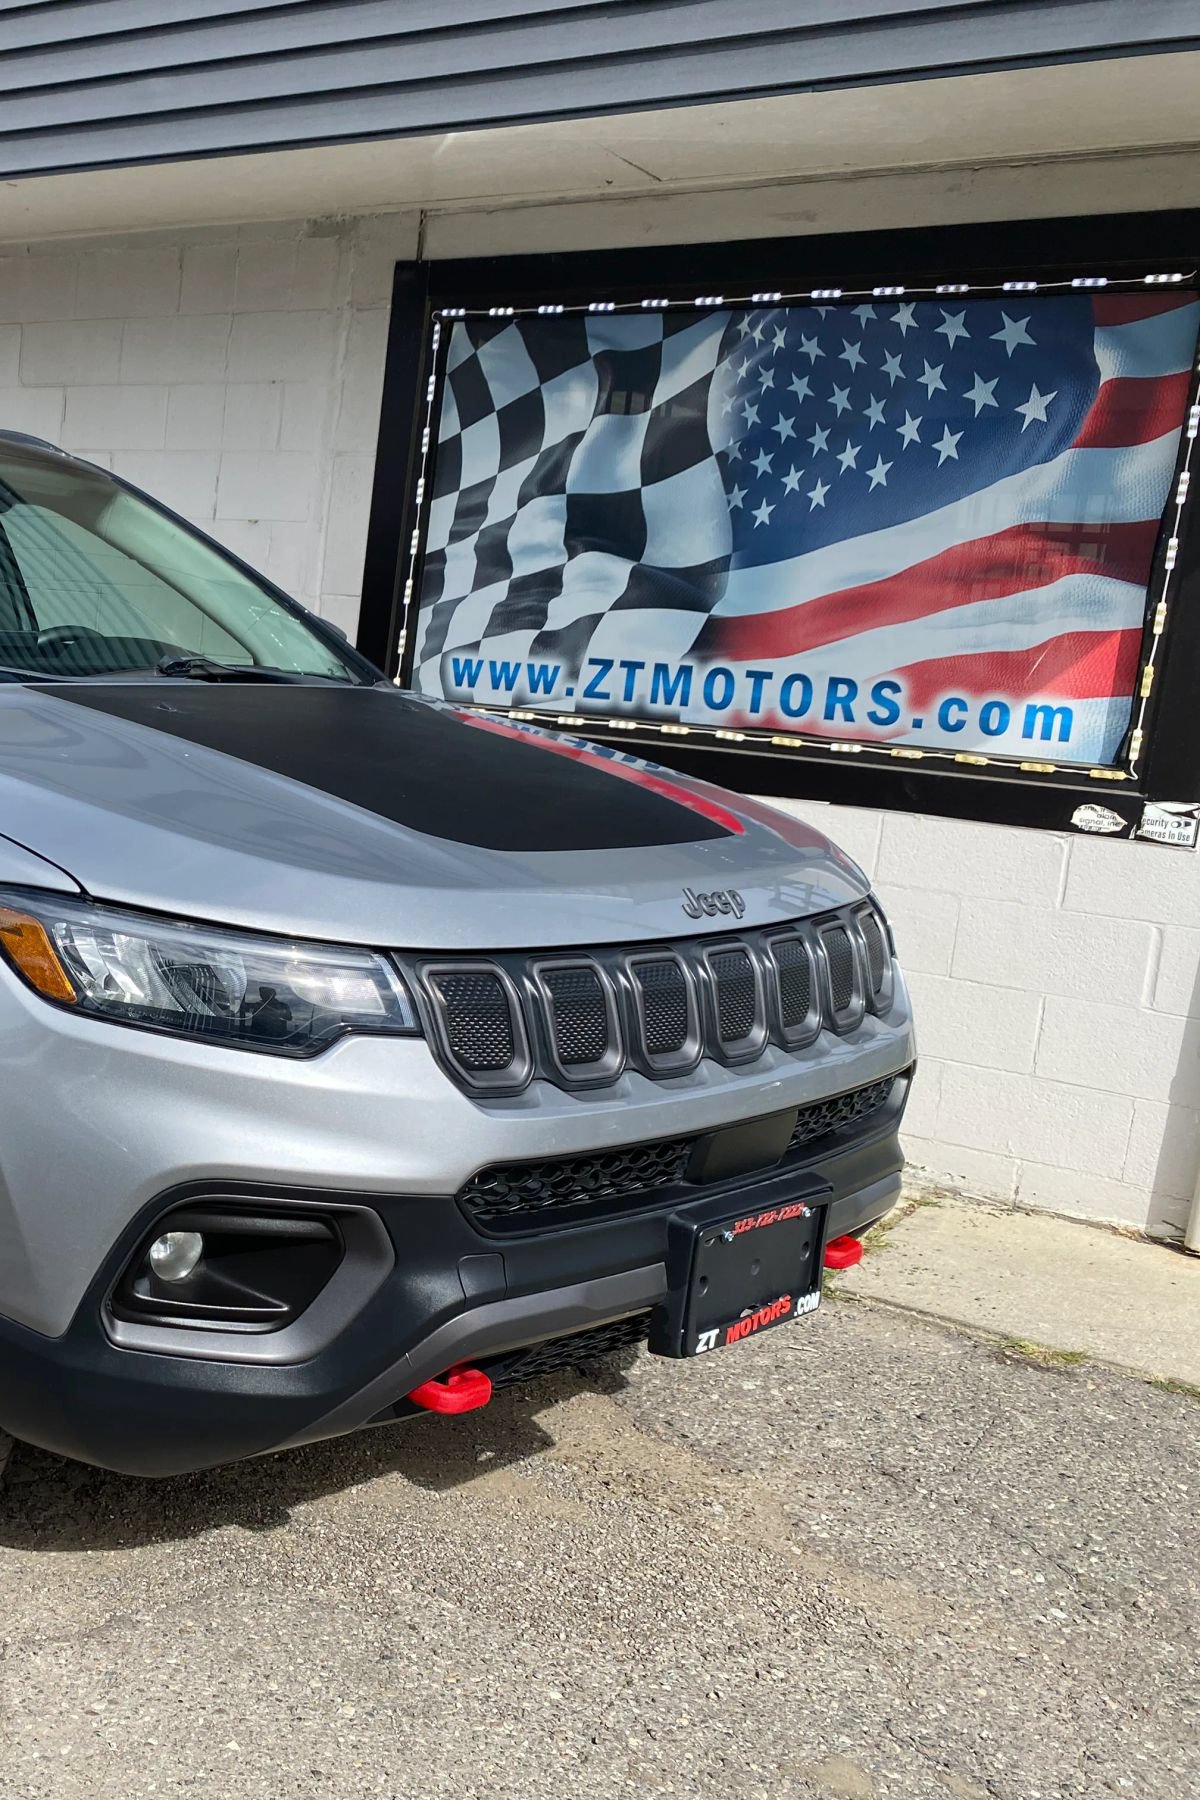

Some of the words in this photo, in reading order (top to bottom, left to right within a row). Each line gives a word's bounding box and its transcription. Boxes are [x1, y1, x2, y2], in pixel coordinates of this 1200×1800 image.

[452, 657, 1074, 743] www.ZTMOTORS.com
[1142, 817, 1169, 829] ecurity
[1177, 832, 1191, 842] Use
[682, 888, 745, 919] Jeep
[695, 1328, 720, 1354] ZT
[725, 1294, 792, 1345] MOTORS
[793, 1290, 821, 1317] .COM
